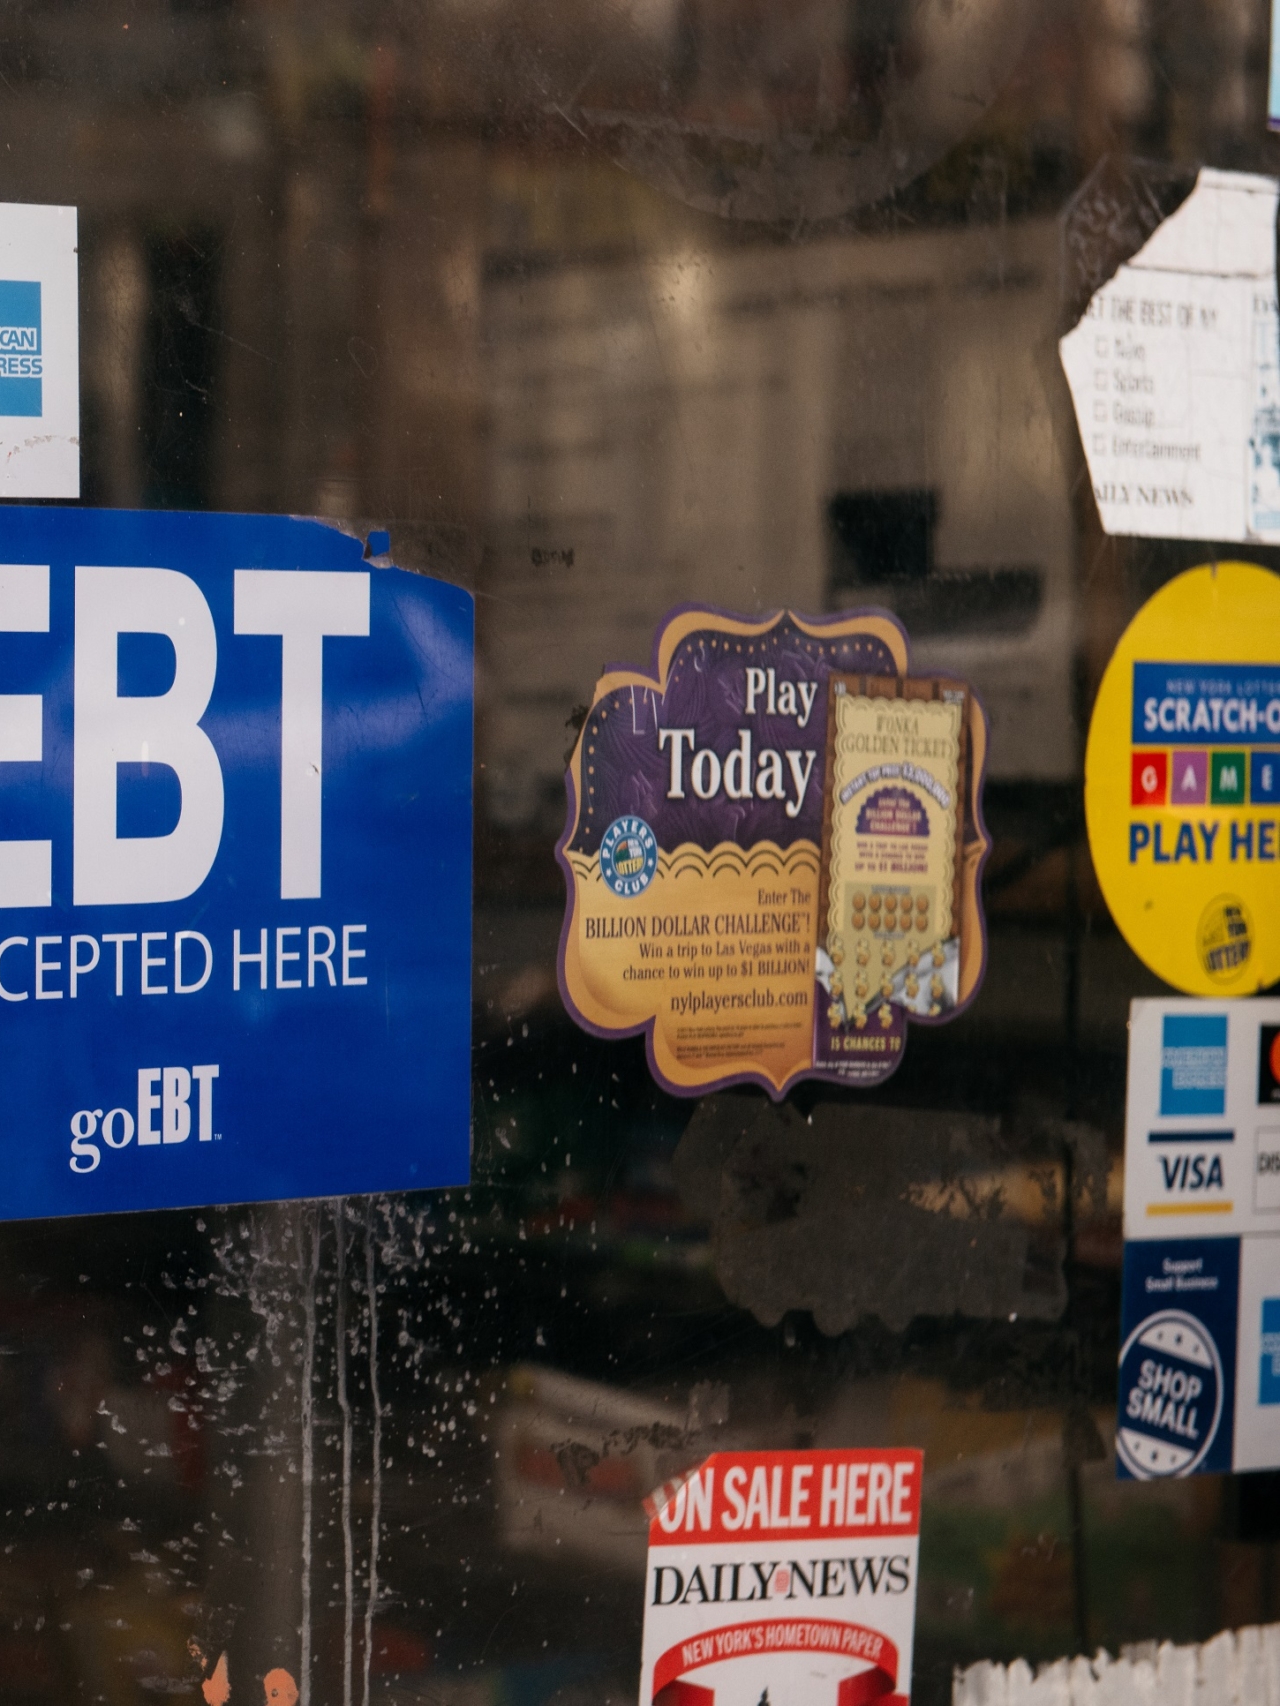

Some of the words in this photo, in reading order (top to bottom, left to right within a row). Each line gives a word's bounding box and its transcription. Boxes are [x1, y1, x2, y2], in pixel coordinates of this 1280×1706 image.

[1138, 485, 1195, 507] NEWS
[745, 667, 818, 726] Play
[1144, 697, 1280, 733] SCRATCH-O
[658, 728, 818, 818] Today
[602, 819, 654, 859] PLAYERS
[1129, 820, 1219, 864] PLAY
[1230, 820, 1280, 863] HE
[614, 872, 649, 895] CLUB
[758, 889, 787, 906] Enter
[790, 888, 811, 905] The
[586, 916, 647, 939] BILLION
[651, 914, 710, 938] DOLLAR
[232, 925, 367, 991] HERE
[623, 965, 665, 981] chance
[669, 965, 680, 979] to
[684, 963, 705, 978] win
[708, 964, 723, 981] up
[727, 963, 737, 977] to
[741, 960, 753, 977] $1
[757, 958, 810, 976] BILLION!
[640, 943, 662, 959] Win
[666, 946, 673, 957] a
[677, 943, 697, 960] trip
[701, 943, 712, 957] to
[716, 941, 735, 956] Las
[739, 940, 772, 957] Vegas
[775, 940, 801, 954] with
[803, 944, 810, 954] a
[671, 988, 808, 1016] nylplayersclub.com
[1159, 1153, 1224, 1191] VISA
[1138, 1358, 1202, 1403] SHOP
[1126, 1386, 1199, 1440] SMALL
[721, 1465, 813, 1531] SALE
[820, 1462, 914, 1527] HERE
[651, 1561, 780, 1606] DAILY
[788, 1555, 911, 1600] NEWS
[682, 1635, 714, 1667] NEW
[715, 1625, 764, 1656] YORK'S
[765, 1623, 842, 1650] HOMETOWN
[842, 1627, 884, 1661] PAPER
